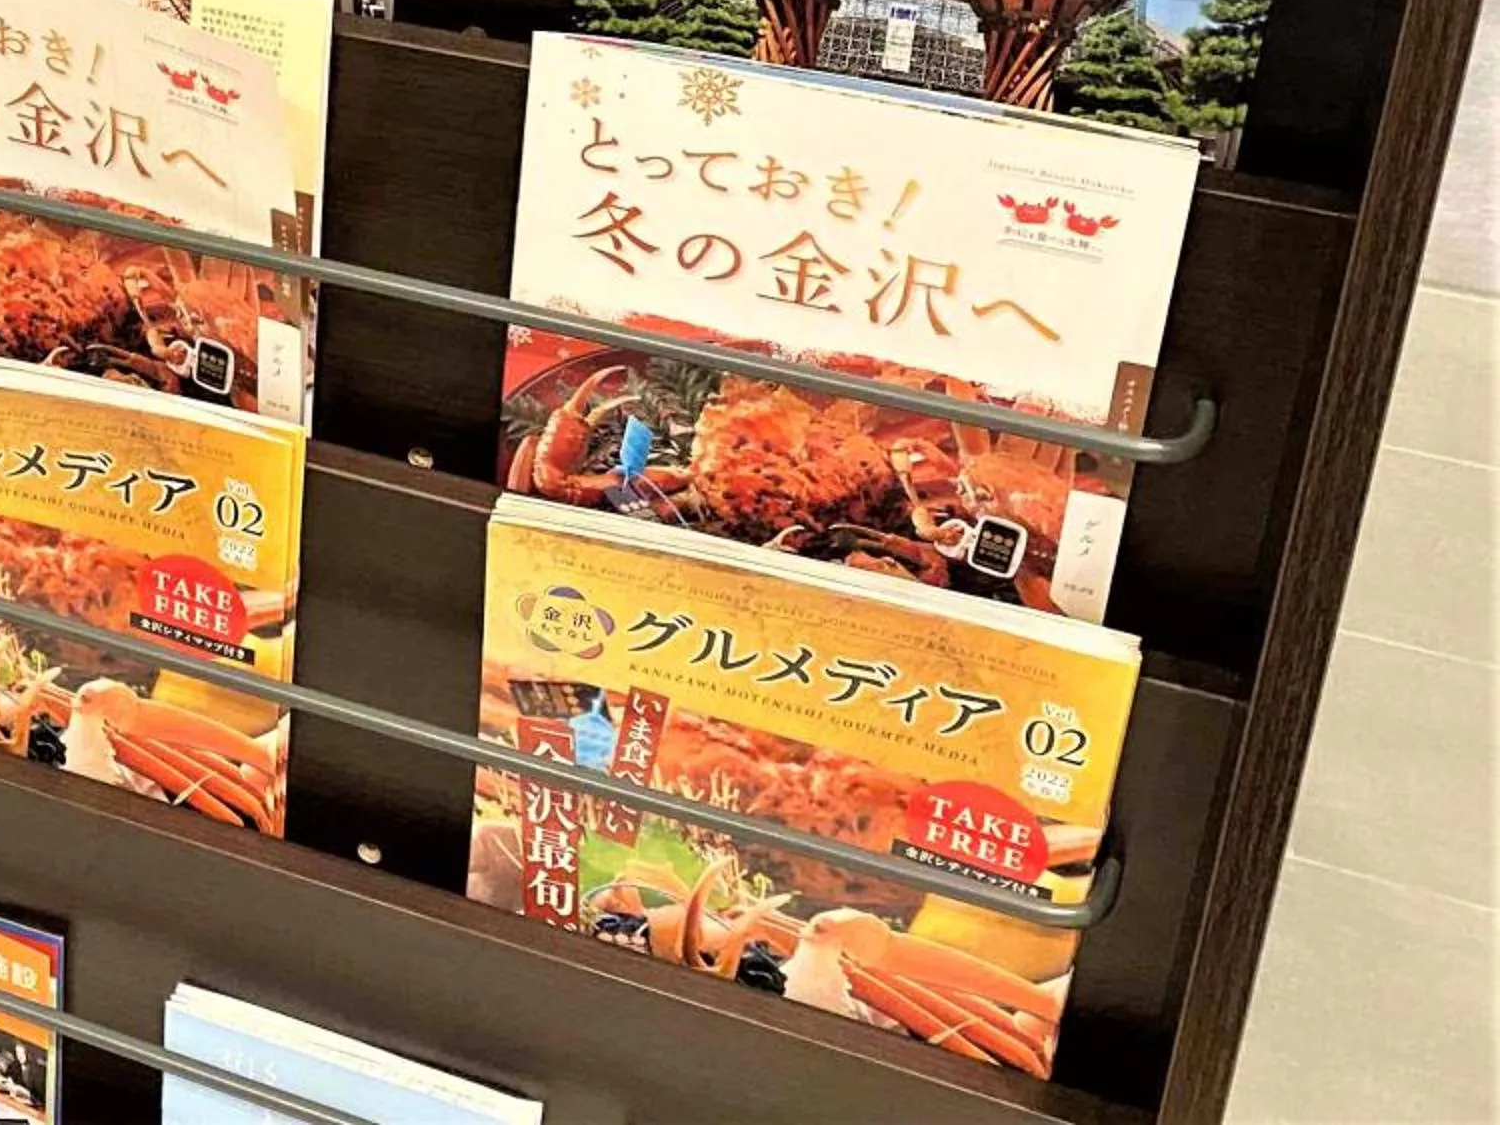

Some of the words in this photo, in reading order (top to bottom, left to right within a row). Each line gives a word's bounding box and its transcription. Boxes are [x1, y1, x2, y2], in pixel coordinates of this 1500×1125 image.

[581, 117, 922, 228] とっておき!
[571, 191, 1061, 342] 冬の金沢へ
[142, 522, 186, 541] MEDIA
[216, 495, 264, 537] 02
[152, 571, 234, 612] TAKE
[155, 595, 231, 637] FREE
[543, 605, 592, 629] 金沢
[627, 611, 1003, 734] グルメディア
[628, 662, 718, 693] KANAZAWA
[724, 687, 824, 720] MOTENASHI
[829, 713, 915, 746] GOURMET
[922, 741, 979, 767] MEDIA
[1044, 703, 1075, 721] Vol
[605, 692, 665, 835] いま食べい
[1025, 720, 1088, 767] 02
[1025, 767, 1071, 788] 2022
[927, 795, 1033, 848] TAKE
[925, 822, 1027, 872] FREE
